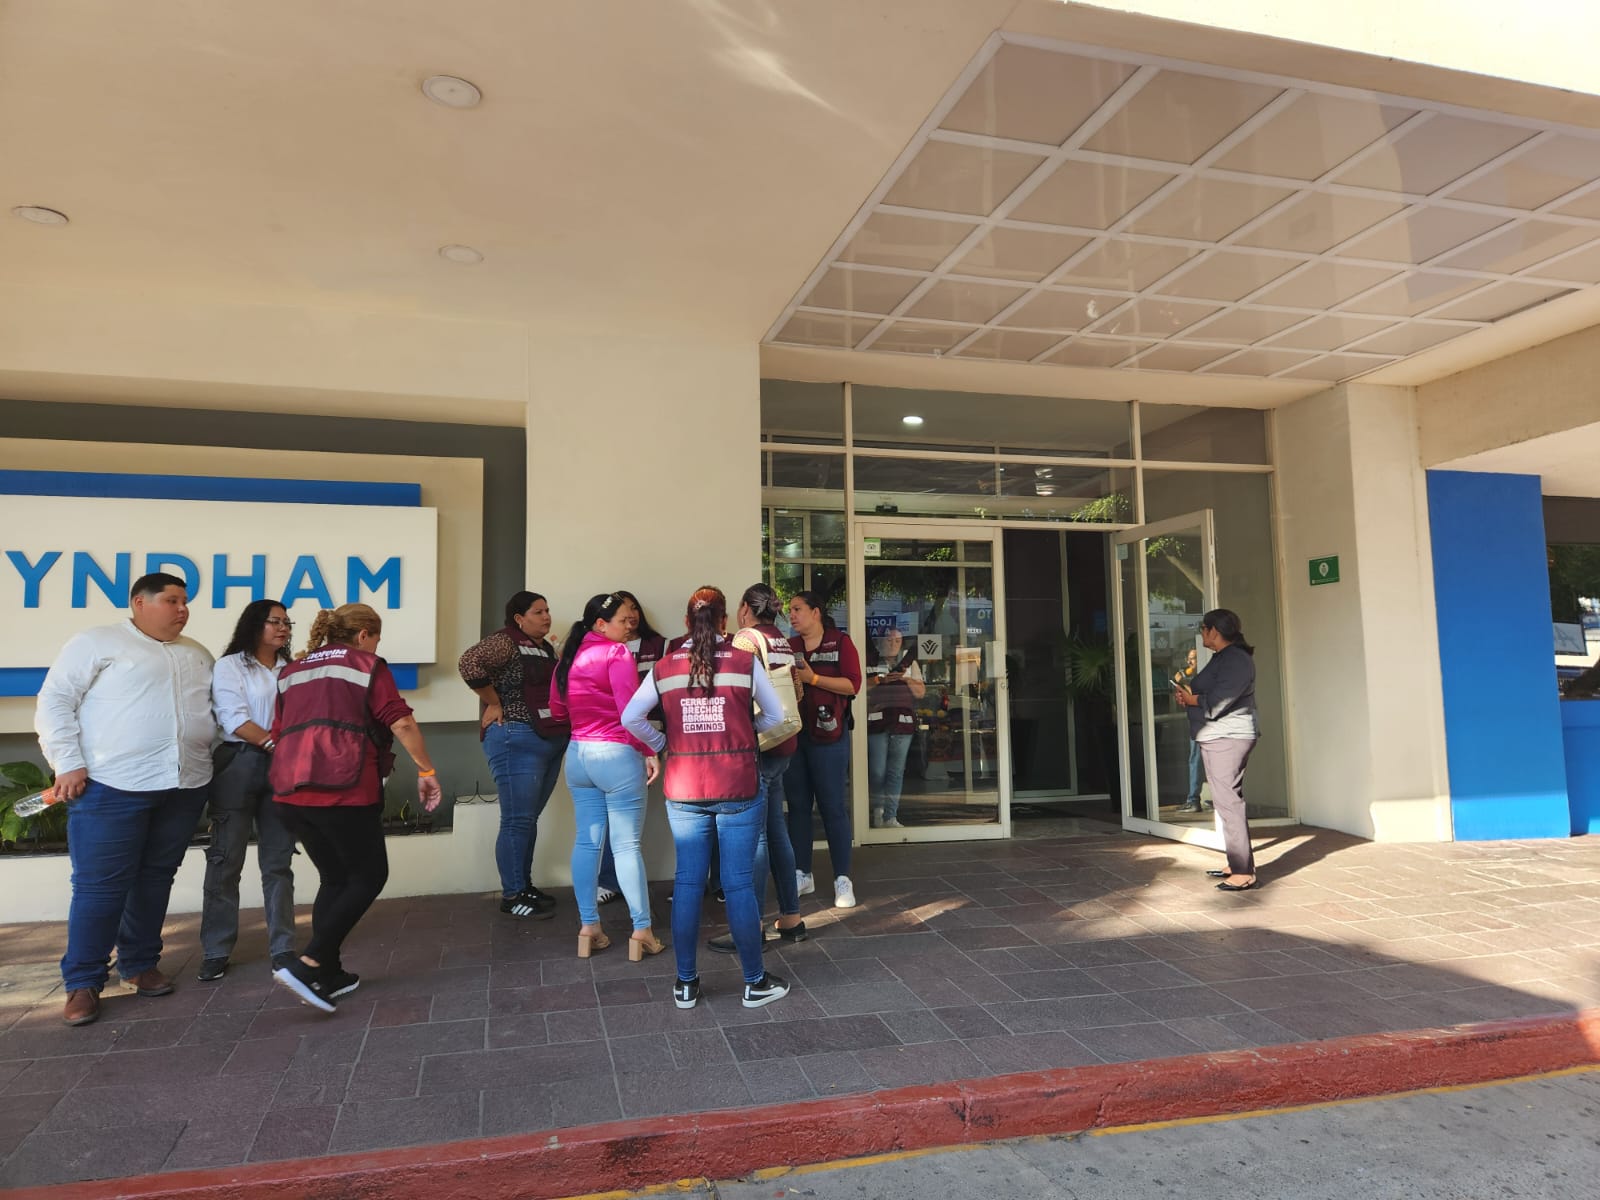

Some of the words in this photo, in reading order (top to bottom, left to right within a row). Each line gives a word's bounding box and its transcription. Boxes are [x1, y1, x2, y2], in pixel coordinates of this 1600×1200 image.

[0, 550, 403, 609] YNDHAM
[680, 696, 725, 707] CERREMOS
[683, 705, 723, 714] BRECHAS
[683, 713, 724, 722] ABRAMOS
[685, 723, 723, 731] CAMINOS
